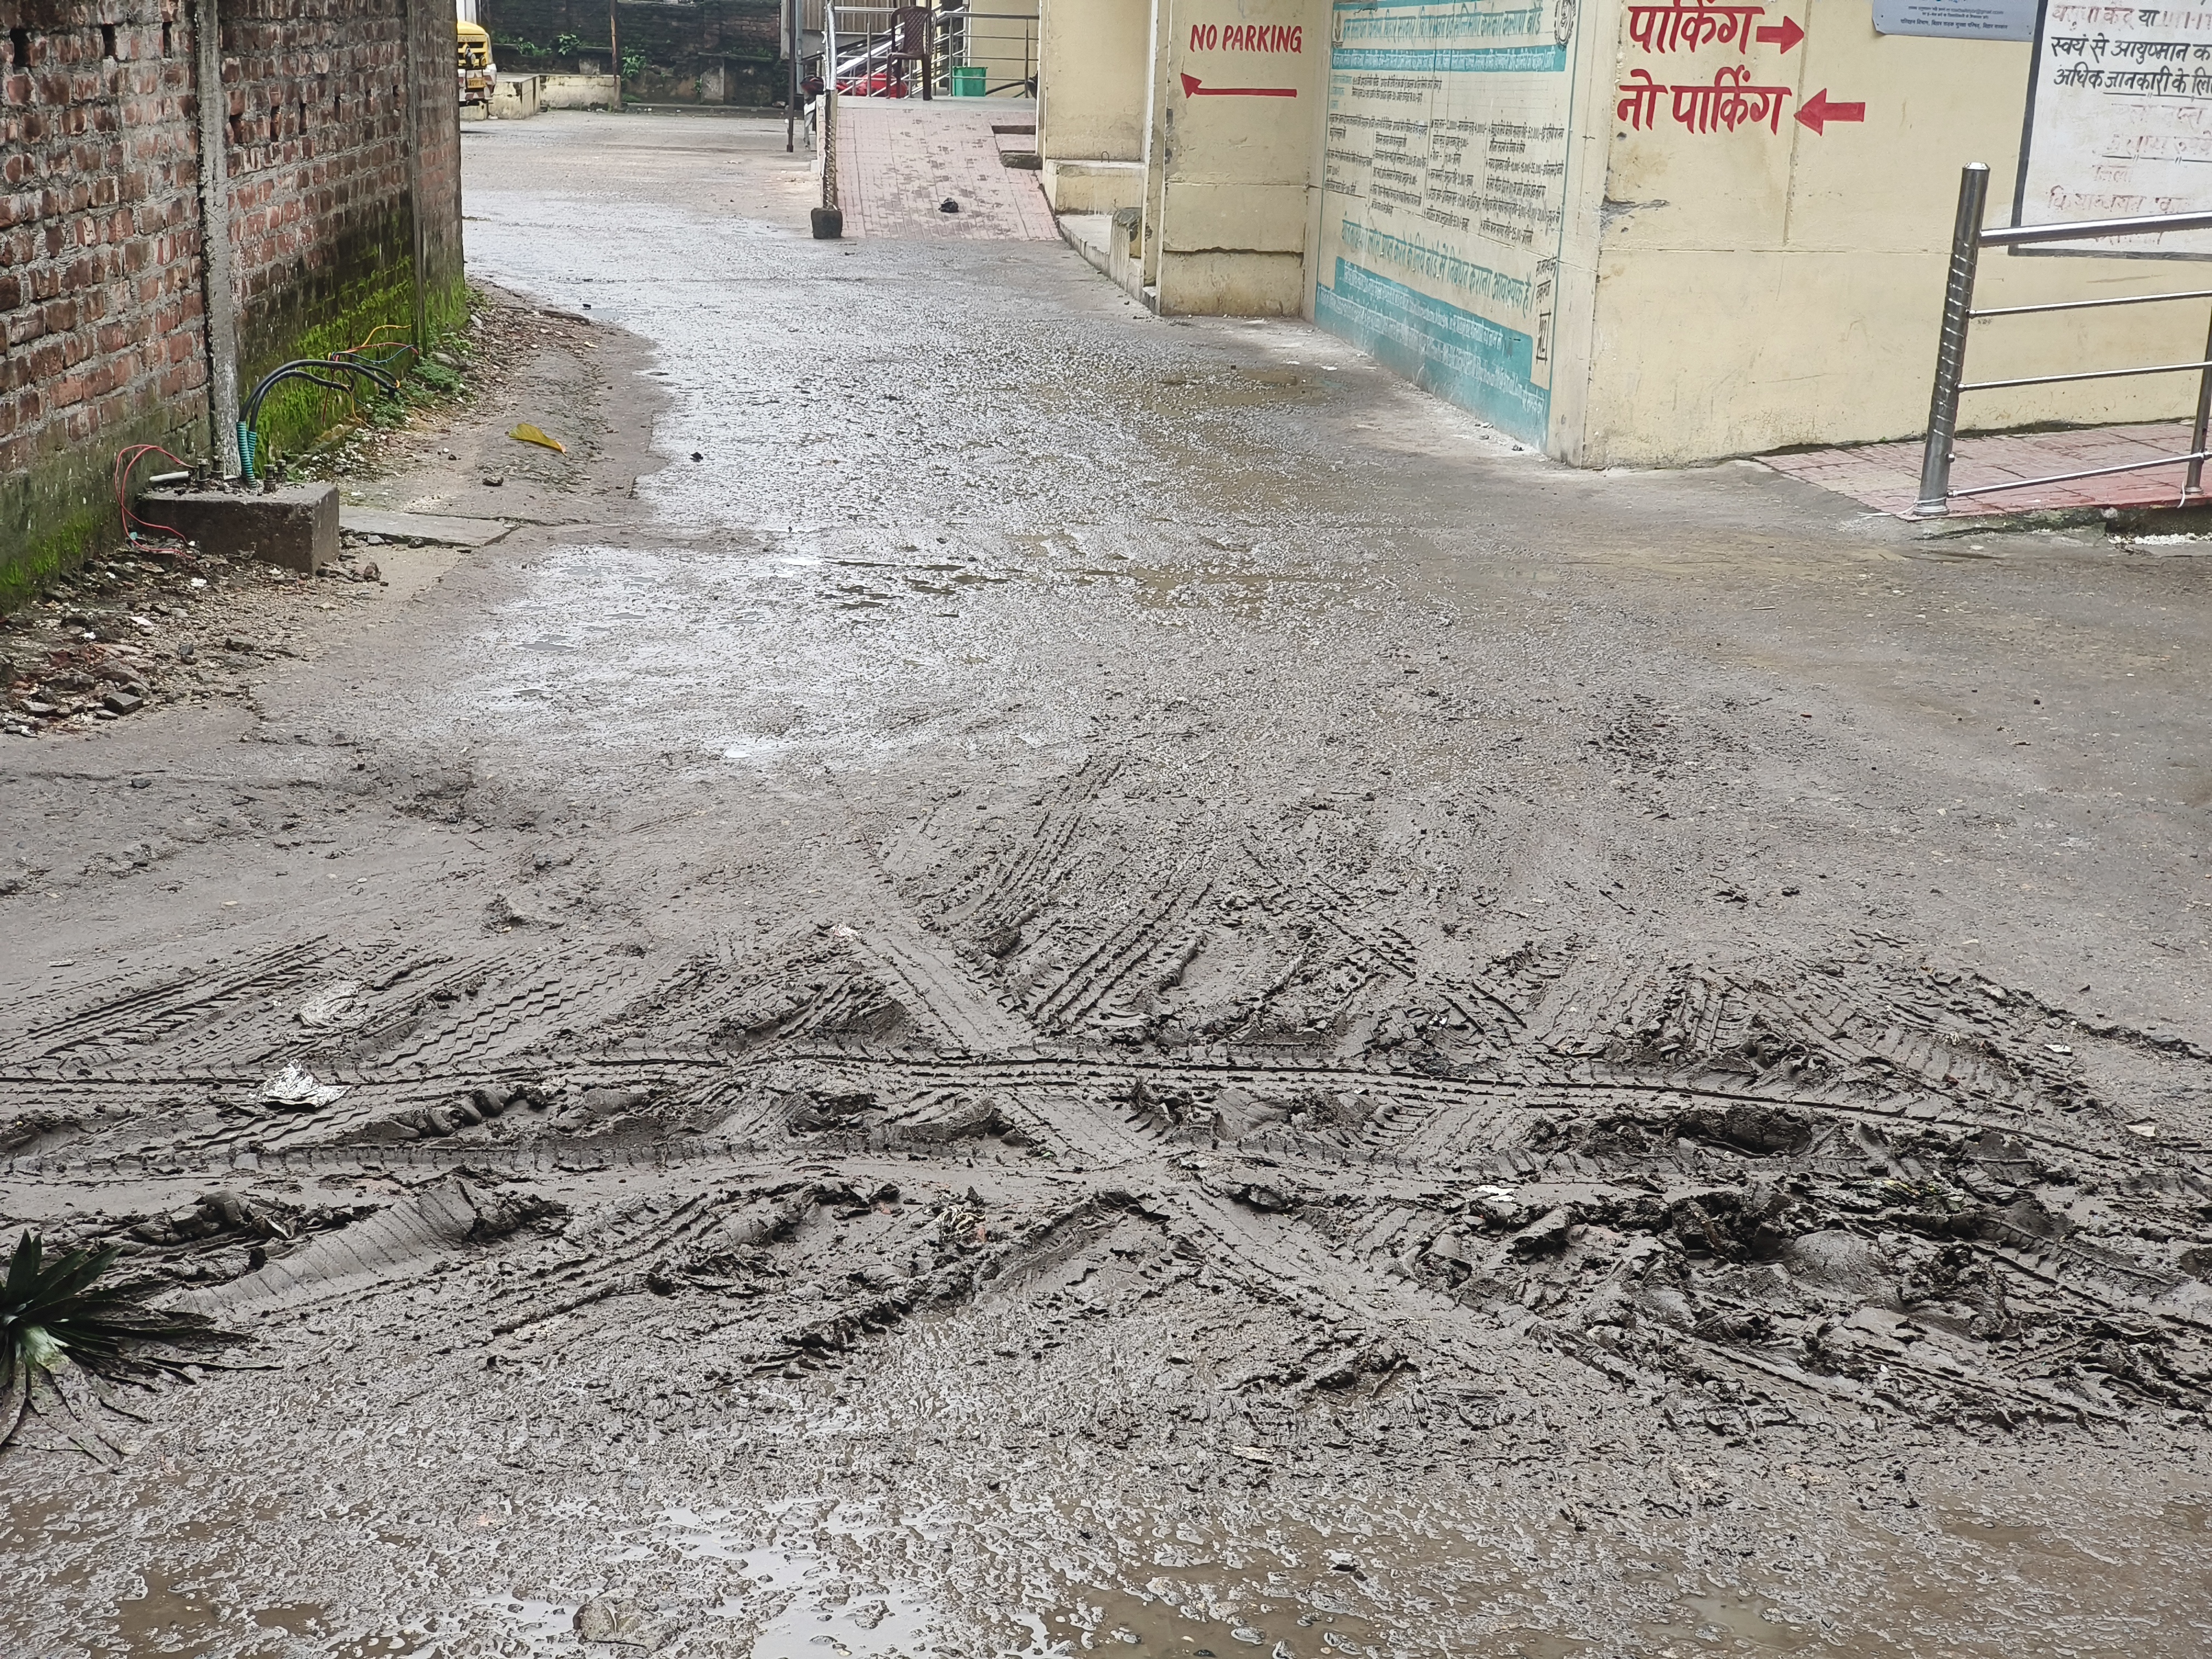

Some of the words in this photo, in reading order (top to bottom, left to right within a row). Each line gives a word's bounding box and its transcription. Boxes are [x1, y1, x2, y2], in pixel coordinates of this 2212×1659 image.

[2138, 9, 2160, 27] या
[1189, 24, 1217, 53] NO
[1222, 24, 1302, 54] PARKING
[2051, 34, 2089, 57] स्वयं
[2090, 33, 2109, 64] से
[2053, 61, 2104, 89] अधिक
[2104, 65, 2172, 95] जानकारी
[2171, 67, 2190, 94] के
[2191, 66, 2212, 96] लि
[1617, 69, 1668, 131] नो
